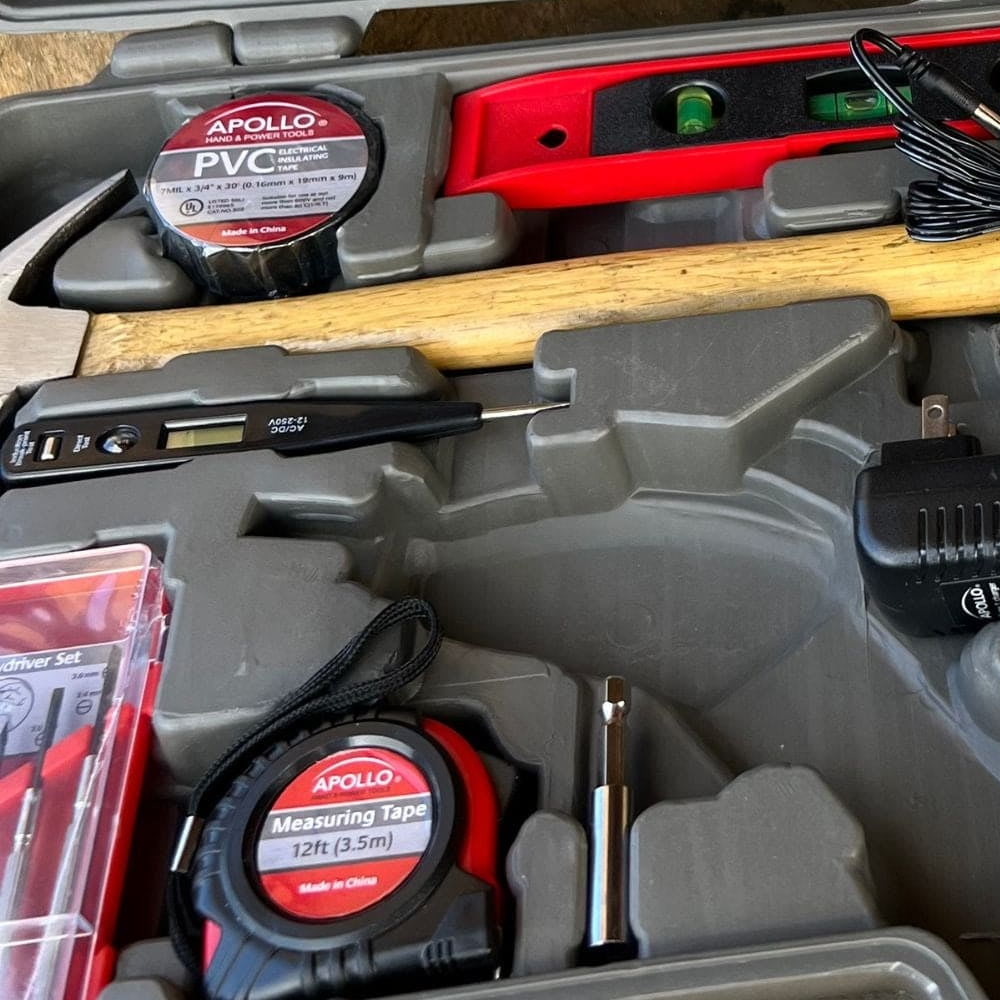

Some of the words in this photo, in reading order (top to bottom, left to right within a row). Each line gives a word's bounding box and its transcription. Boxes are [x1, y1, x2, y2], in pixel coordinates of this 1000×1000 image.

[207, 114, 316, 136] APOLLO
[205, 135, 233, 144] HAND
[234, 134, 242, 143] &
[244, 131, 280, 142] POWER
[283, 128, 315, 139] TOOLS
[277, 152, 329, 163] INSULATING
[278, 144, 328, 156] ELECTRICAL
[193, 147, 277, 178] PVC
[277, 164, 298, 173] TAPE
[160, 186, 184, 195] 7MIL
[221, 226, 248, 237] Made
[248, 226, 259, 235] in
[259, 225, 287, 234] China
[268, 416, 308, 427] 12-250V
[270, 424, 305, 434] AC/DC
[970, 588, 993, 618] APOLLO
[54, 650, 83, 667] Set
[312, 769, 394, 793] APOLLO
[272, 809, 375, 834] Measuring
[381, 803, 427, 822] Tape
[293, 841, 328, 858] 12ft
[334, 831, 394, 857] (3.5m)
[298, 881, 332, 895] Made
[332, 879, 345, 889] in
[345, 876, 378, 889] China
